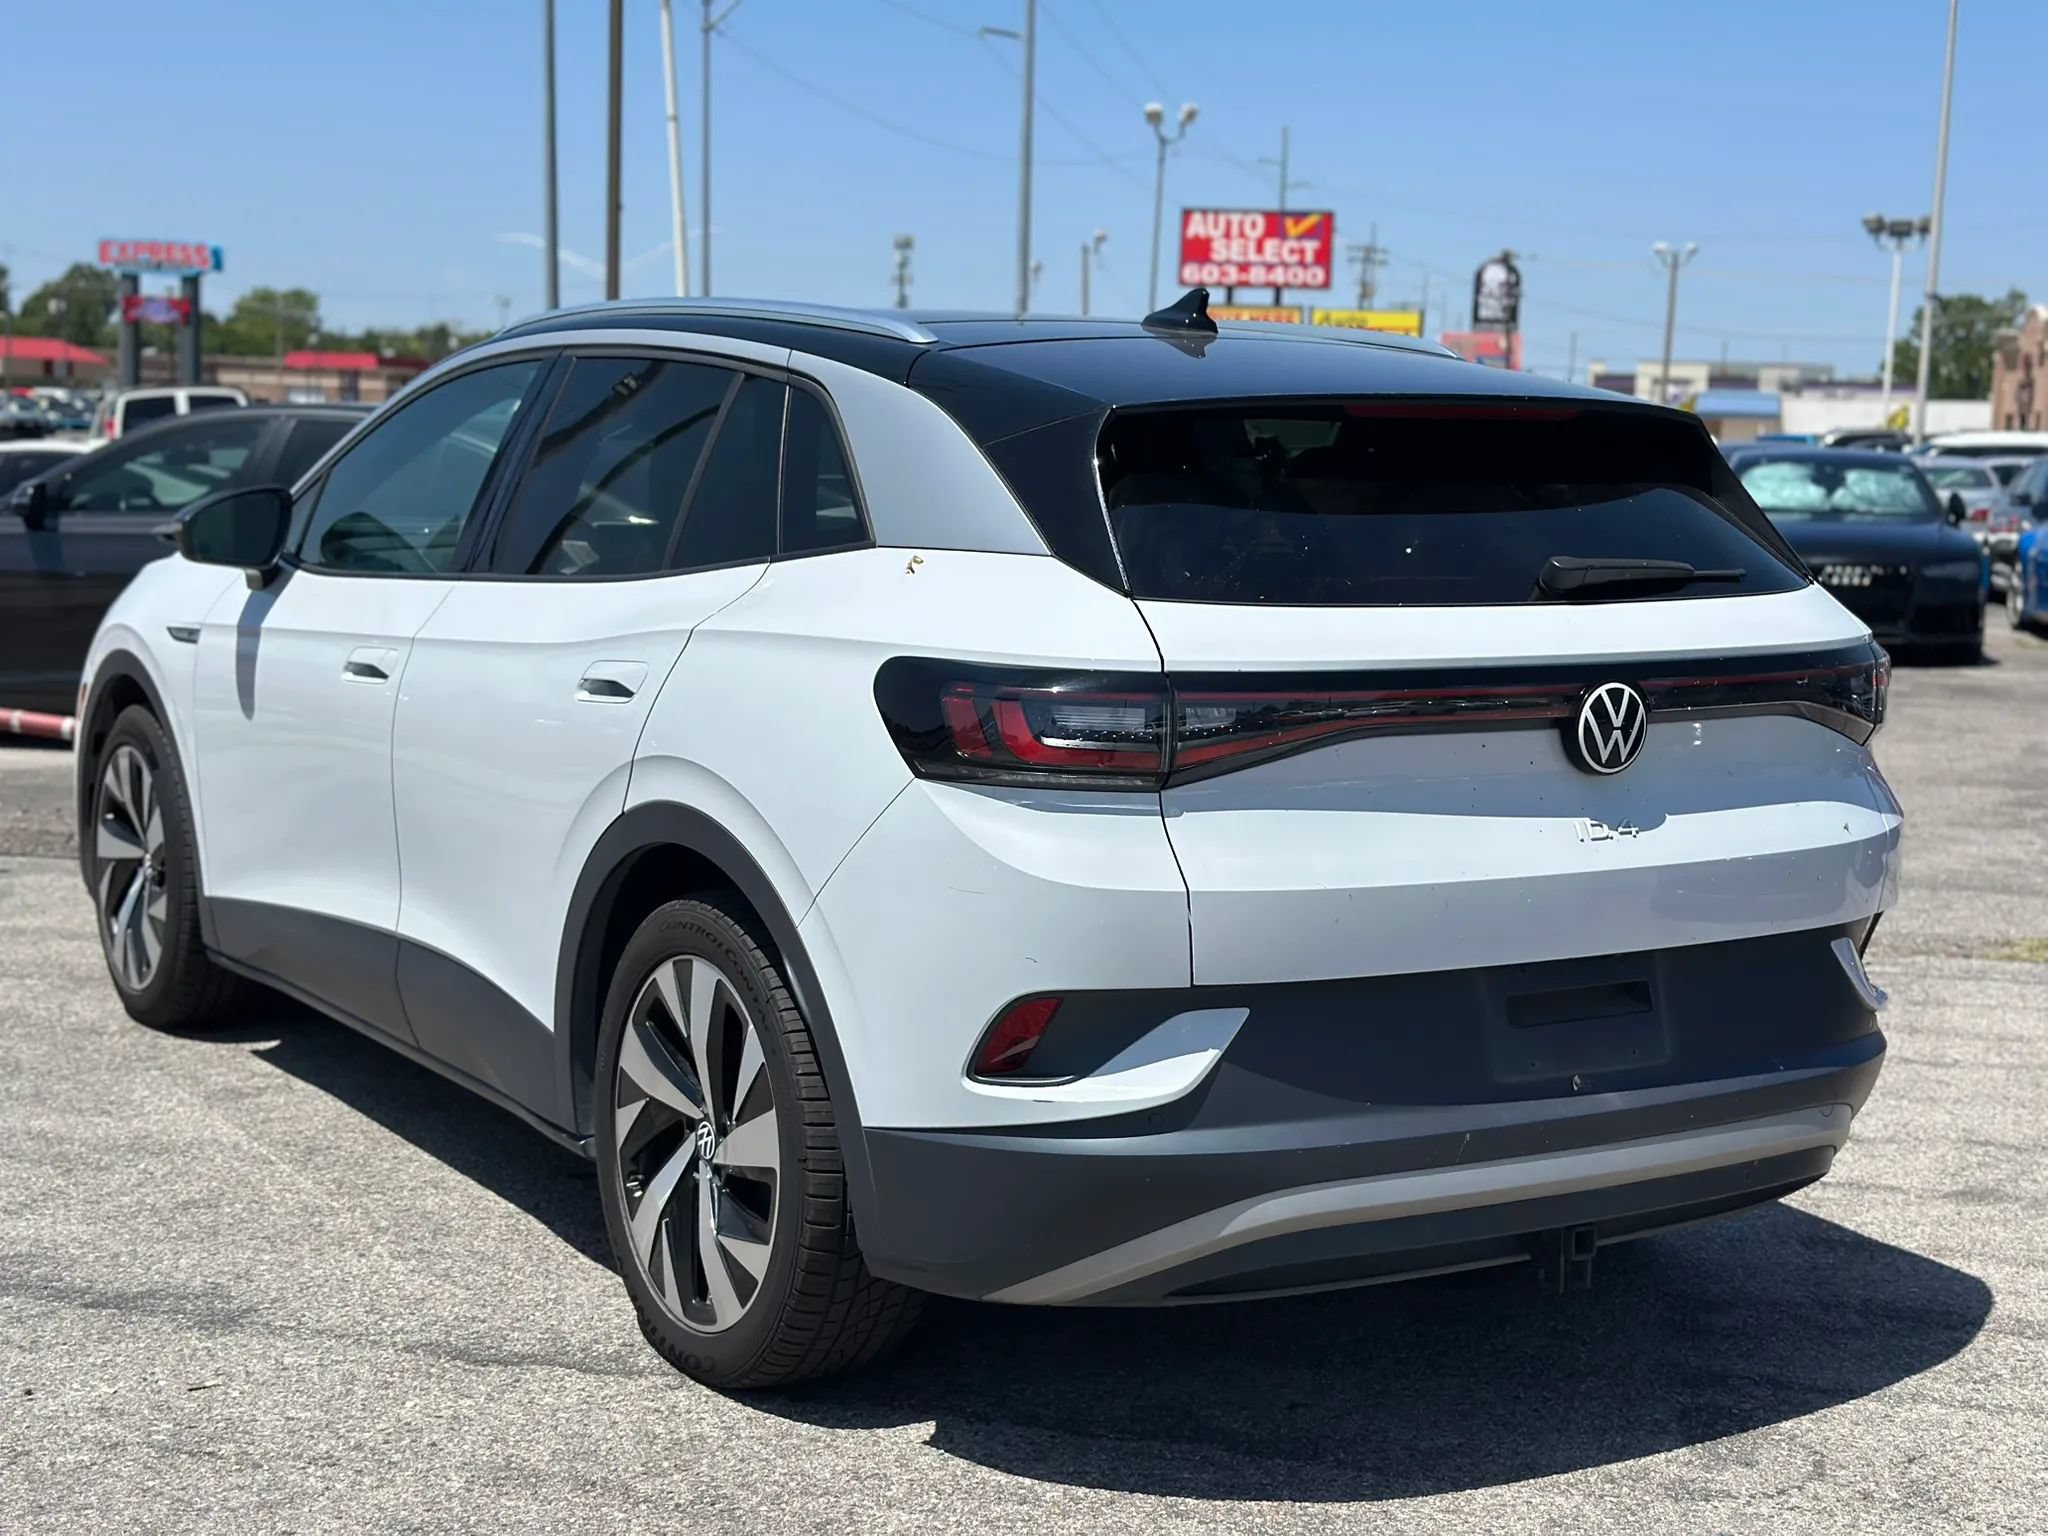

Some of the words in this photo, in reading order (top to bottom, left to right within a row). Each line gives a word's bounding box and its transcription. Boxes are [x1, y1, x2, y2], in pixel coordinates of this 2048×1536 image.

[1187, 213, 1265, 238] AUTO
[100, 241, 210, 268] EXPRESS
[1211, 238, 1320, 263] SELECT
[1182, 263, 1325, 285] 603-8400
